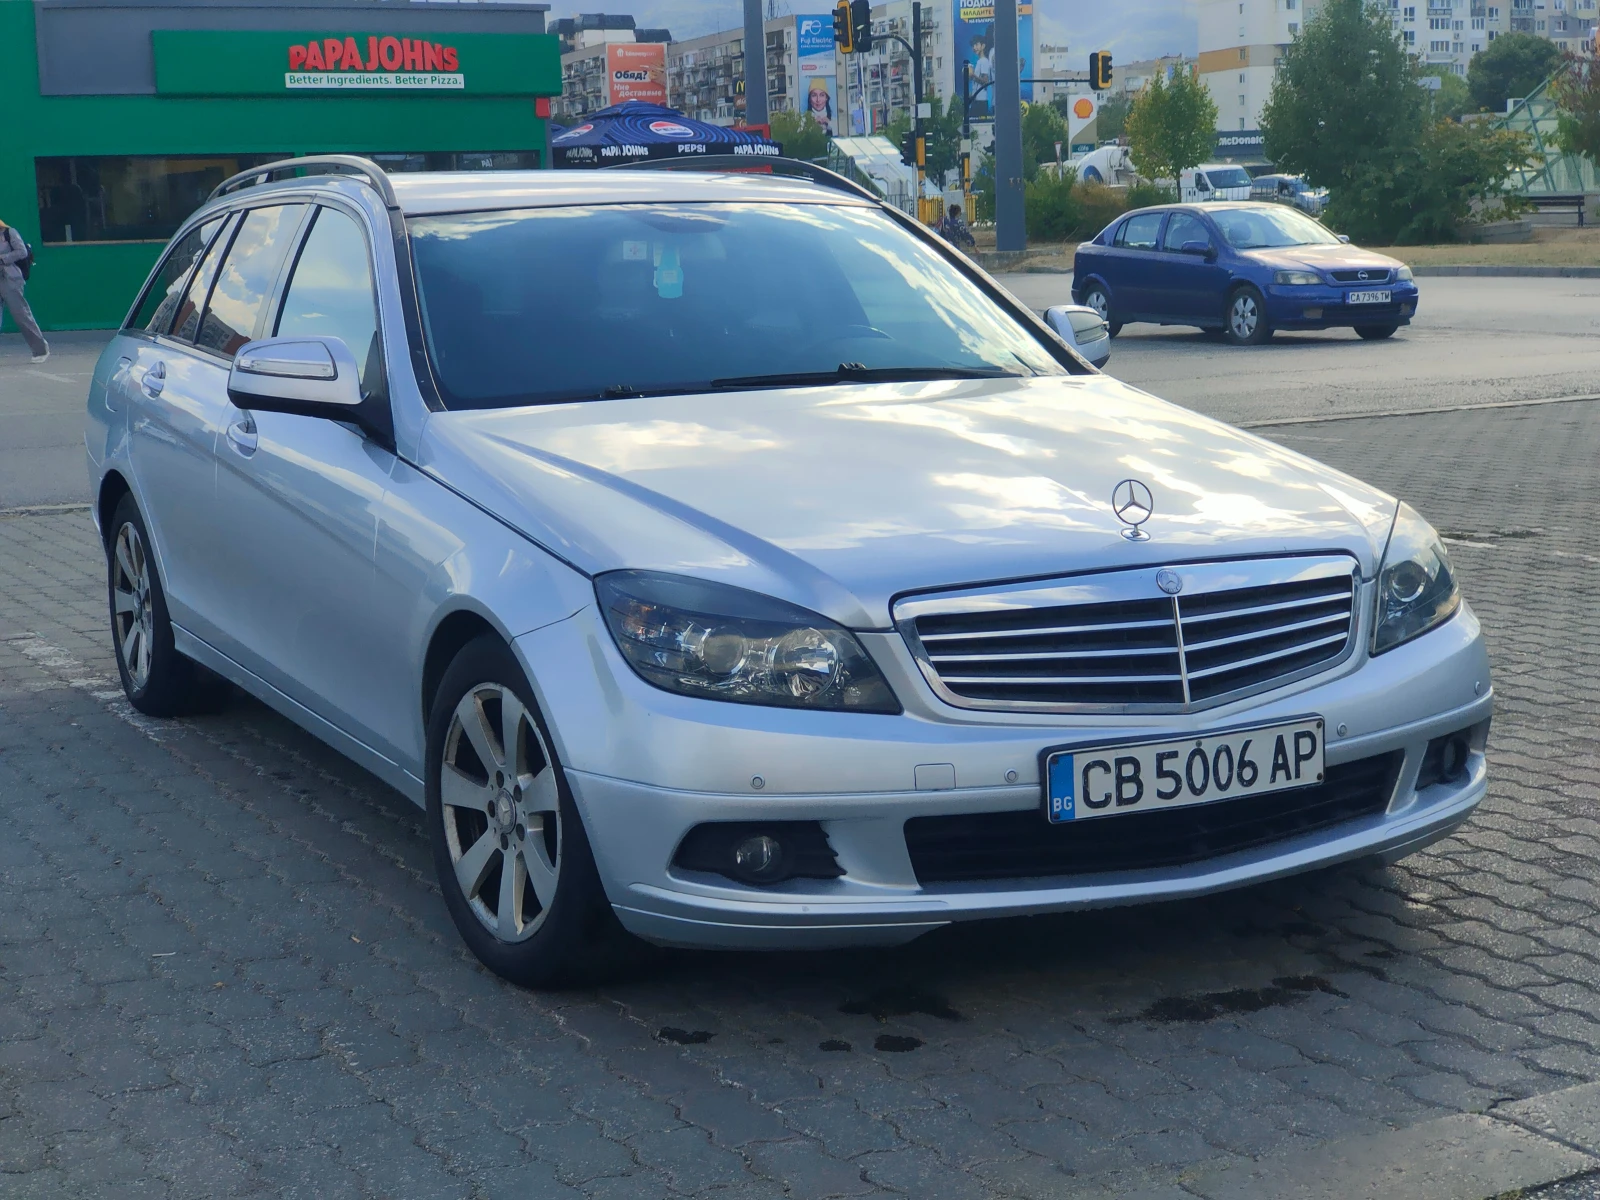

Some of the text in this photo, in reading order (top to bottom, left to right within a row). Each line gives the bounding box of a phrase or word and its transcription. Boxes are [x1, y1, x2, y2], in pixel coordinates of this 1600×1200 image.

[289, 36, 459, 71] PAPA JOHNS
[289, 75, 462, 86] Better Ingredients. Better Pizza.
[615, 71, 648, 80] Обяд?
[619, 90, 662, 98] доставяме
[622, 145, 649, 156] JOHNS
[678, 144, 706, 153] PEPSI
[734, 145, 779, 155] PAPA JOHNS
[1350, 292, 1390, 302] CA 7396 TM
[1053, 730, 1317, 812] BG CB 5006 AP
